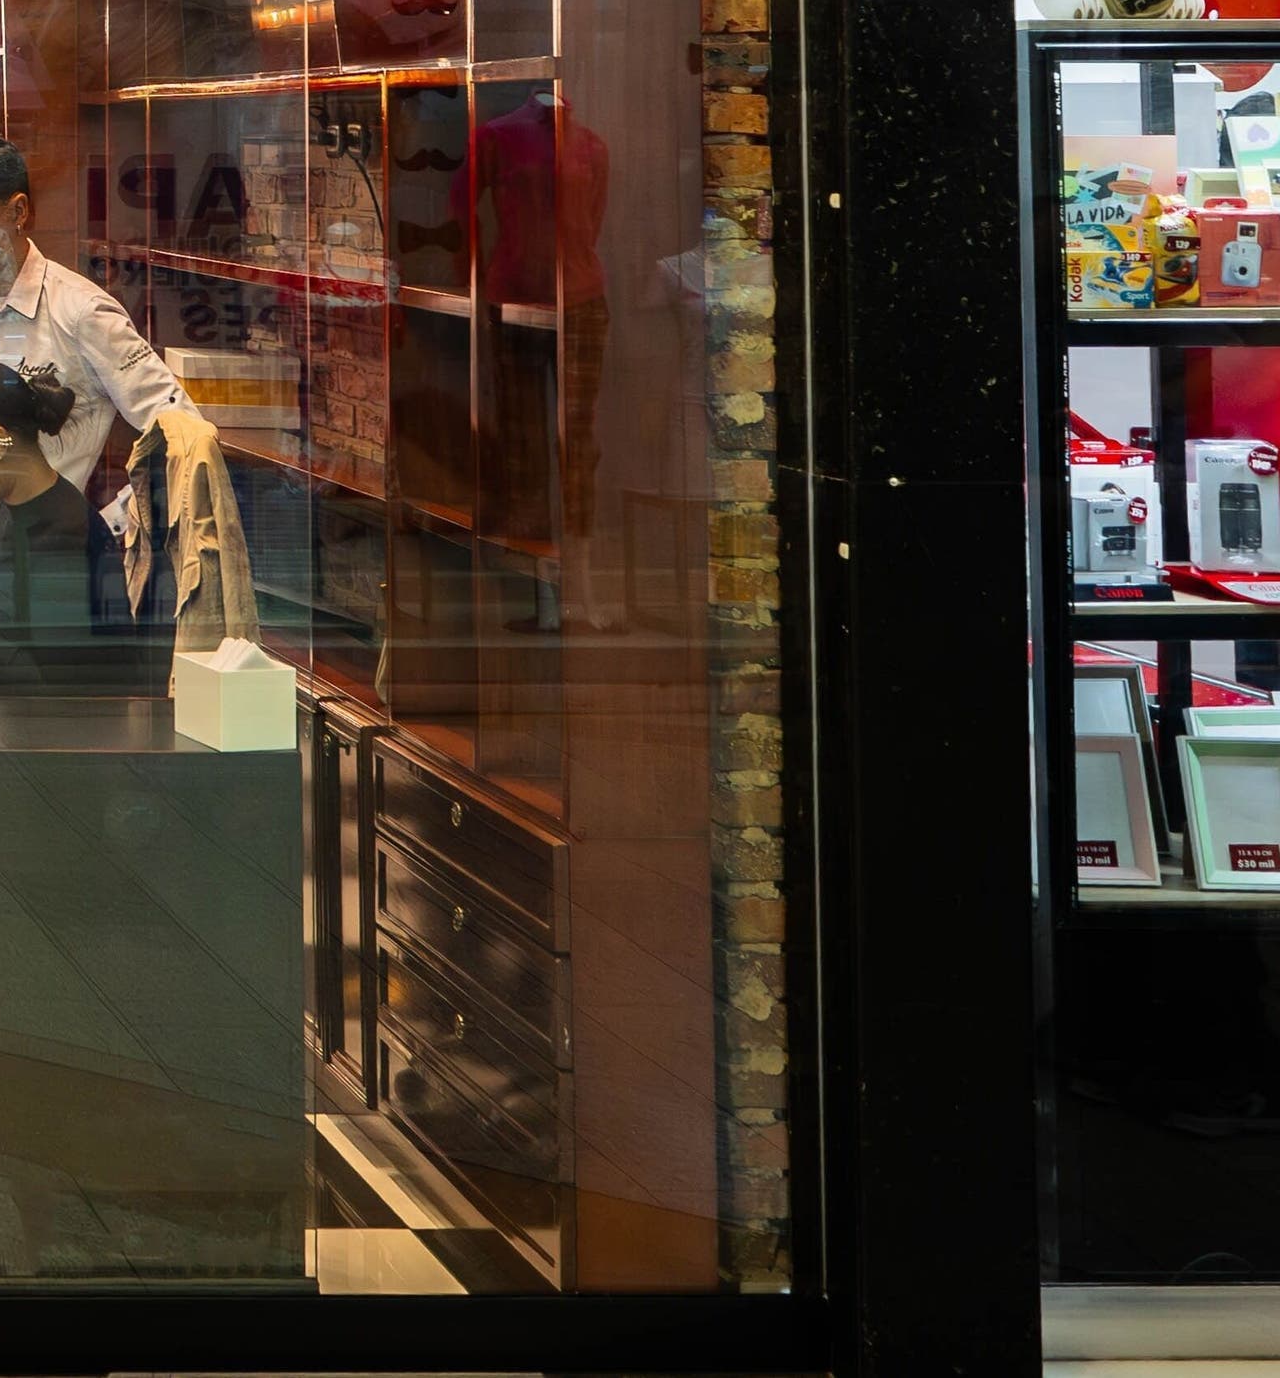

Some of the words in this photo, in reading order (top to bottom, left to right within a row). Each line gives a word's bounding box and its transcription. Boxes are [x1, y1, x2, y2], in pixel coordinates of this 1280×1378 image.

[1068, 210, 1084, 224] LA
[1090, 205, 1125, 224] VIDA
[1069, 256, 1082, 303] Kodak
[1093, 586, 1145, 599] Canon
[1248, 583, 1280, 593] Cano
[1095, 855, 1111, 865] mil
[1237, 859, 1257, 869] $30
[1259, 859, 1276, 869] mil
